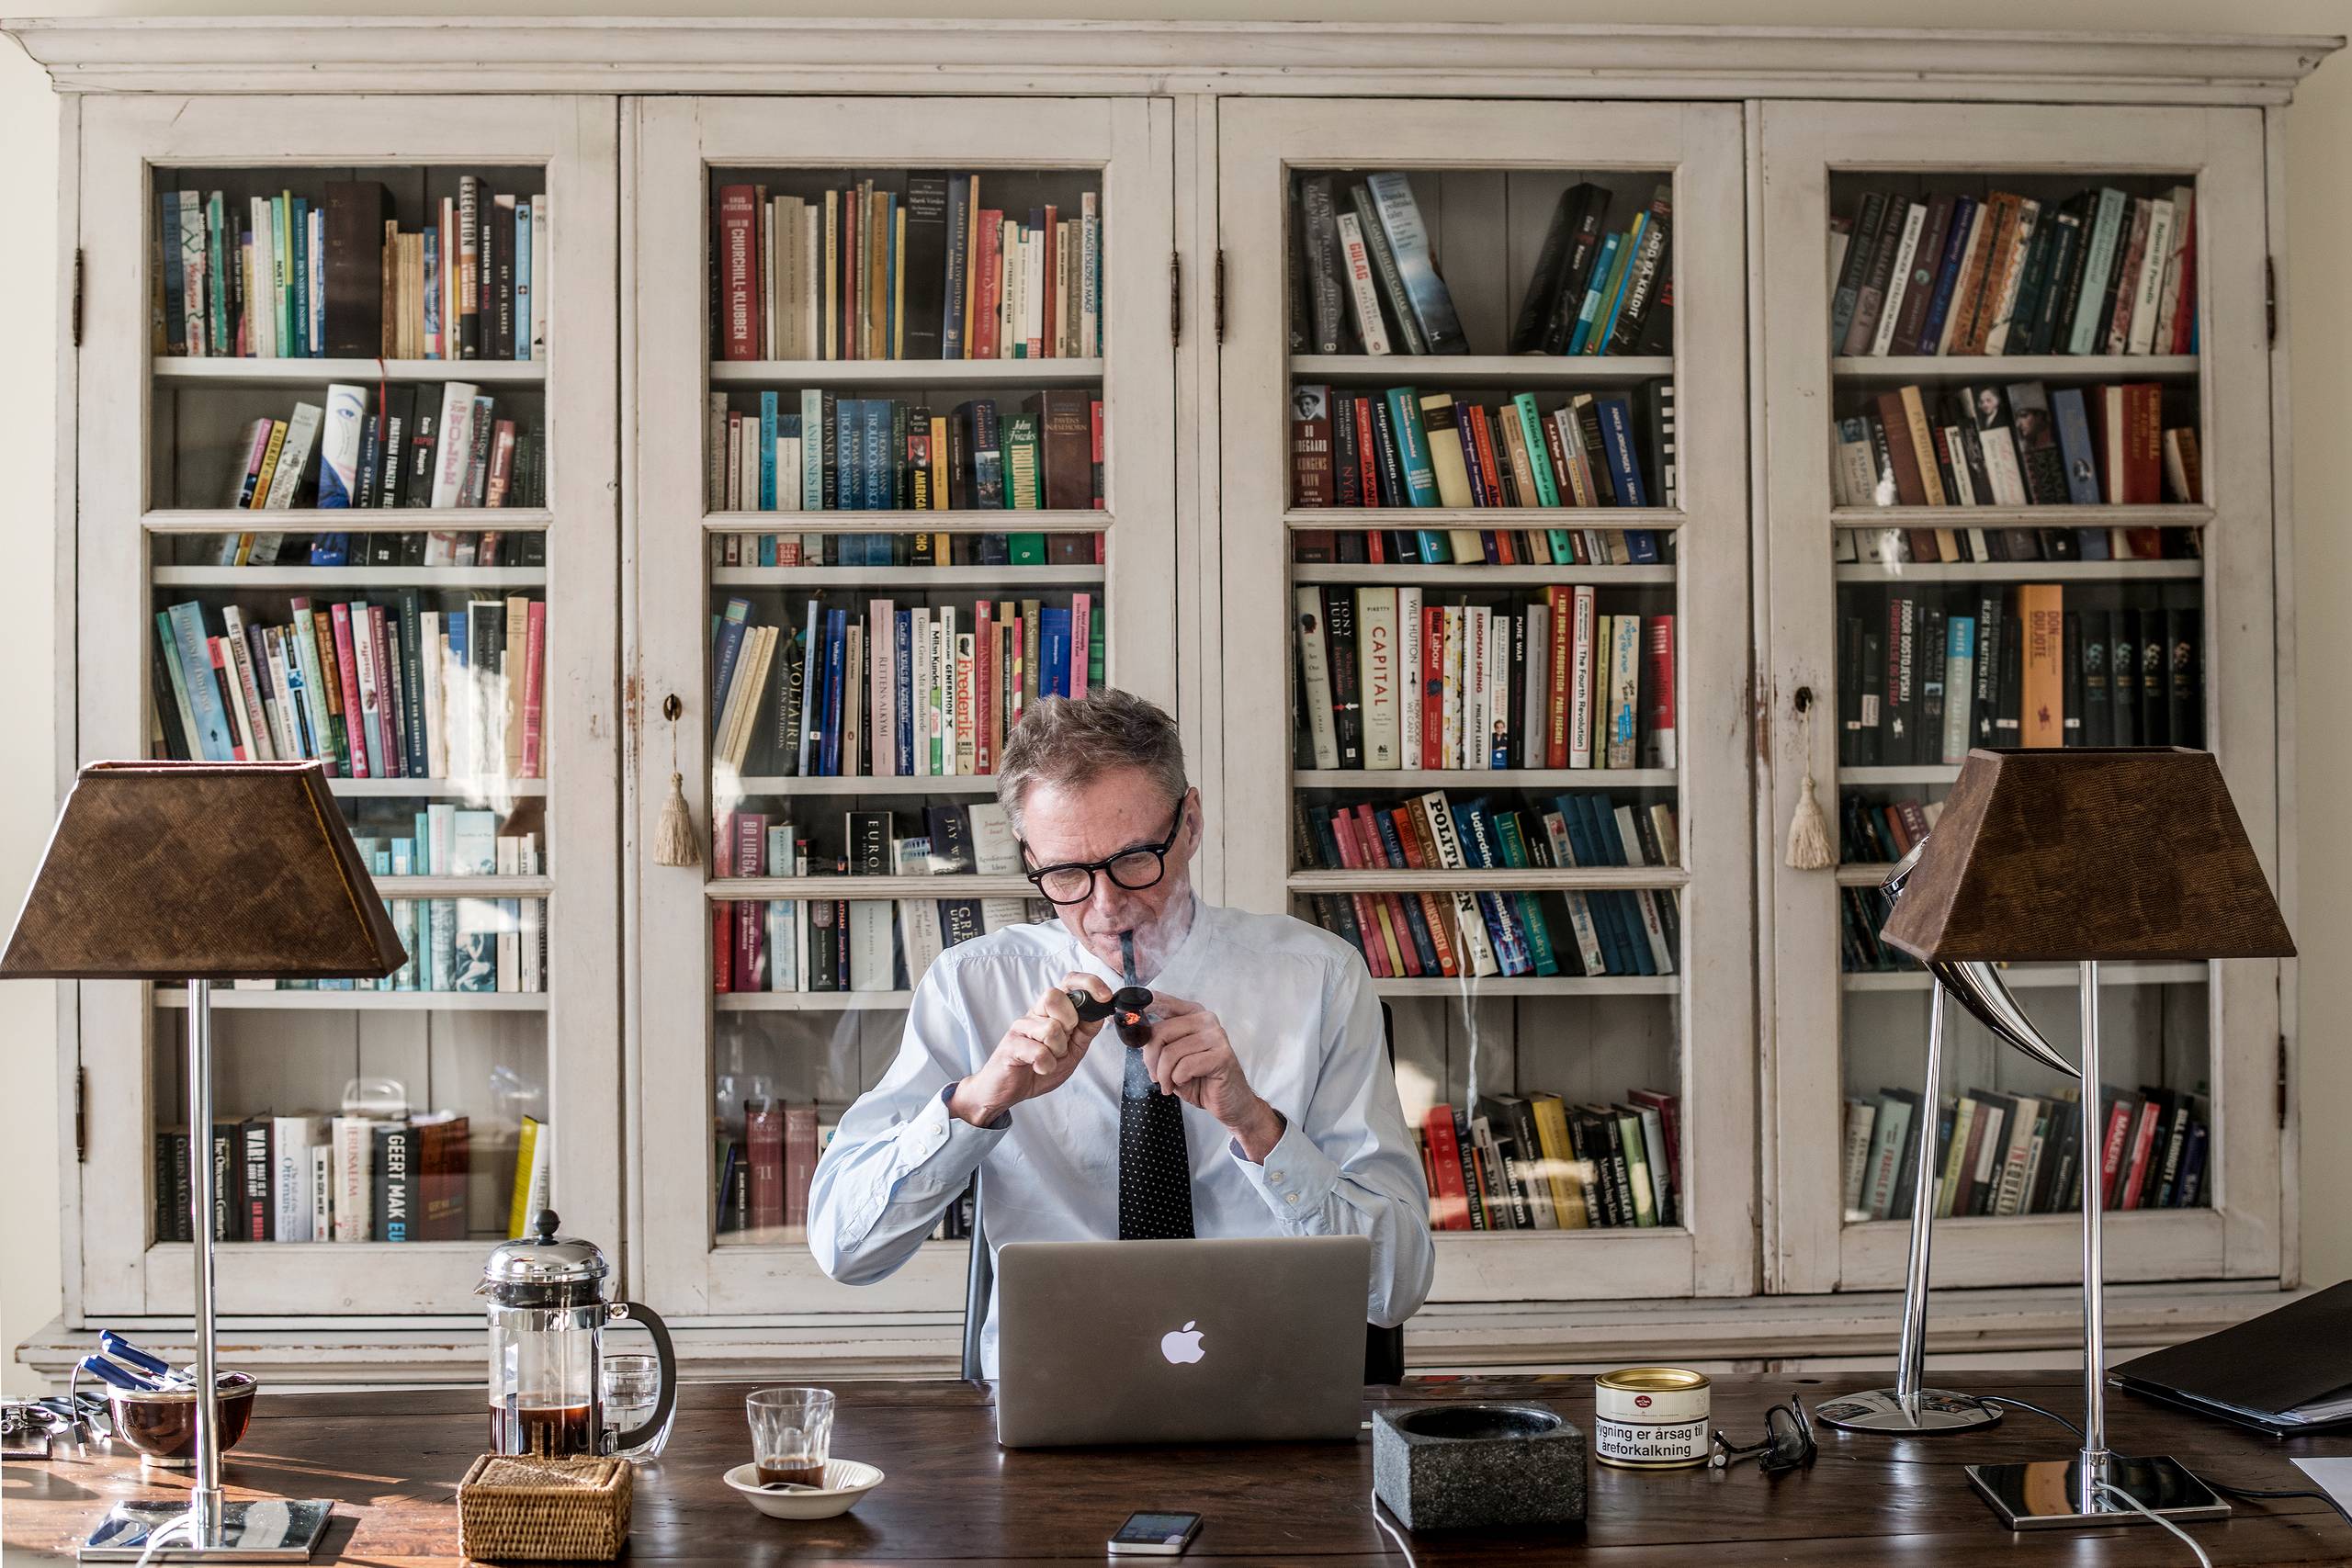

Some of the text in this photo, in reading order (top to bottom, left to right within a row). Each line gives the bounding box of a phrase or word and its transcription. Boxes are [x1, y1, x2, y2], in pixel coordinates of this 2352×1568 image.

[463, 183, 475, 247] EXECUTION
[954, 202, 965, 318] ANPARTER AF EN LIVSHISTORIE
[1084, 215, 1094, 314] DE MAGTESLØSES MAGT
[1349, 243, 1369, 280] GULAG
[1628, 231, 1662, 320] DØD PÅ KREDIT
[731, 229, 747, 340] CHURCHILL-KLUBBEN
[1360, 287, 1375, 333] APPLEBAUM
[1369, 298, 1379, 319] ANNE
[823, 395, 833, 413] The
[369, 417, 378, 434] Paul
[823, 417, 834, 468] MONKEY
[976, 405, 988, 449] Germinal
[1012, 419, 1031, 432] John
[1305, 425, 1314, 437] BO
[1377, 402, 1398, 479] Retspræsidenten
[1611, 408, 1632, 474] ANKER JØRGENSEN
[2149, 389, 2160, 460] CHURCHILL
[385, 417, 401, 490] JONATHAN FRANZEN
[1514, 448, 1530, 485] Caspar
[1556, 459, 1567, 486] Bismarck
[1856, 447, 1872, 501] RASPUTIN
[1487, 483, 1499, 507] Albe
[918, 617, 927, 644] Günter
[1330, 601, 1341, 637] JUDT
[1340, 599, 1352, 637] TONY
[1409, 599, 1419, 664] WILL HUTTON
[1982, 601, 1992, 626] REJSE
[2049, 611, 2060, 637] DON
[932, 631, 940, 656] Milan
[1982, 627, 1991, 639] TIL
[2033, 611, 2046, 660] QUIJOTE
[361, 641, 372, 683] Filosoffer
[831, 641, 840, 666] Voltaire
[900, 650, 909, 674] MORALS
[1373, 626, 1387, 706] CAPITAL
[1890, 664, 1900, 677] OG
[1900, 636, 1912, 703] DOSTOJEVSKIJ
[1979, 640, 1989, 677] NATTENS
[273, 663, 286, 701] Buddha
[878, 657, 888, 737] RETTENS ALKYMI
[900, 676, 909, 684] BY
[786, 661, 803, 750] VOLTAIRE
[900, 686, 910, 723] AGREEMENT
[919, 689, 928, 732] århundrede
[957, 659, 973, 739] Frederik
[1577, 650, 1588, 748] The Fourth Revolution
[779, 705, 787, 749] DAVIDSON
[945, 718, 953, 729] X
[1555, 716, 1564, 745] FISCHER
[742, 821, 757, 835] BO
[944, 819, 958, 840] JAY
[1470, 812, 1493, 869] Udfordring
[1430, 799, 1474, 912] POLITIEN
[2174, 1108, 2188, 1134] BILL
[247, 1130, 266, 1161] WAR!
[348, 1127, 359, 1198] JERUSALEM
[388, 1135, 405, 1181] GEERT
[2104, 1115, 2129, 1174] MAKERS
[215, 1138, 226, 1199] The Ottoman
[248, 1164, 256, 1197] GOOD FOR?
[257, 1164, 266, 1180] WHAT
[282, 1157, 293, 1213] Ottomans
[1461, 1143, 1479, 1212] KURT STRAND
[1613, 1156, 1626, 1184] KLAUS
[254, 1201, 264, 1215] IAN
[390, 1185, 405, 1219] MAK
[1602, 1438, 1691, 1457] åreforkalkning
[1637, 1430, 1651, 1440] er
[1656, 1427, 1691, 1441] årsag
[1694, 1424, 1703, 1437] til
